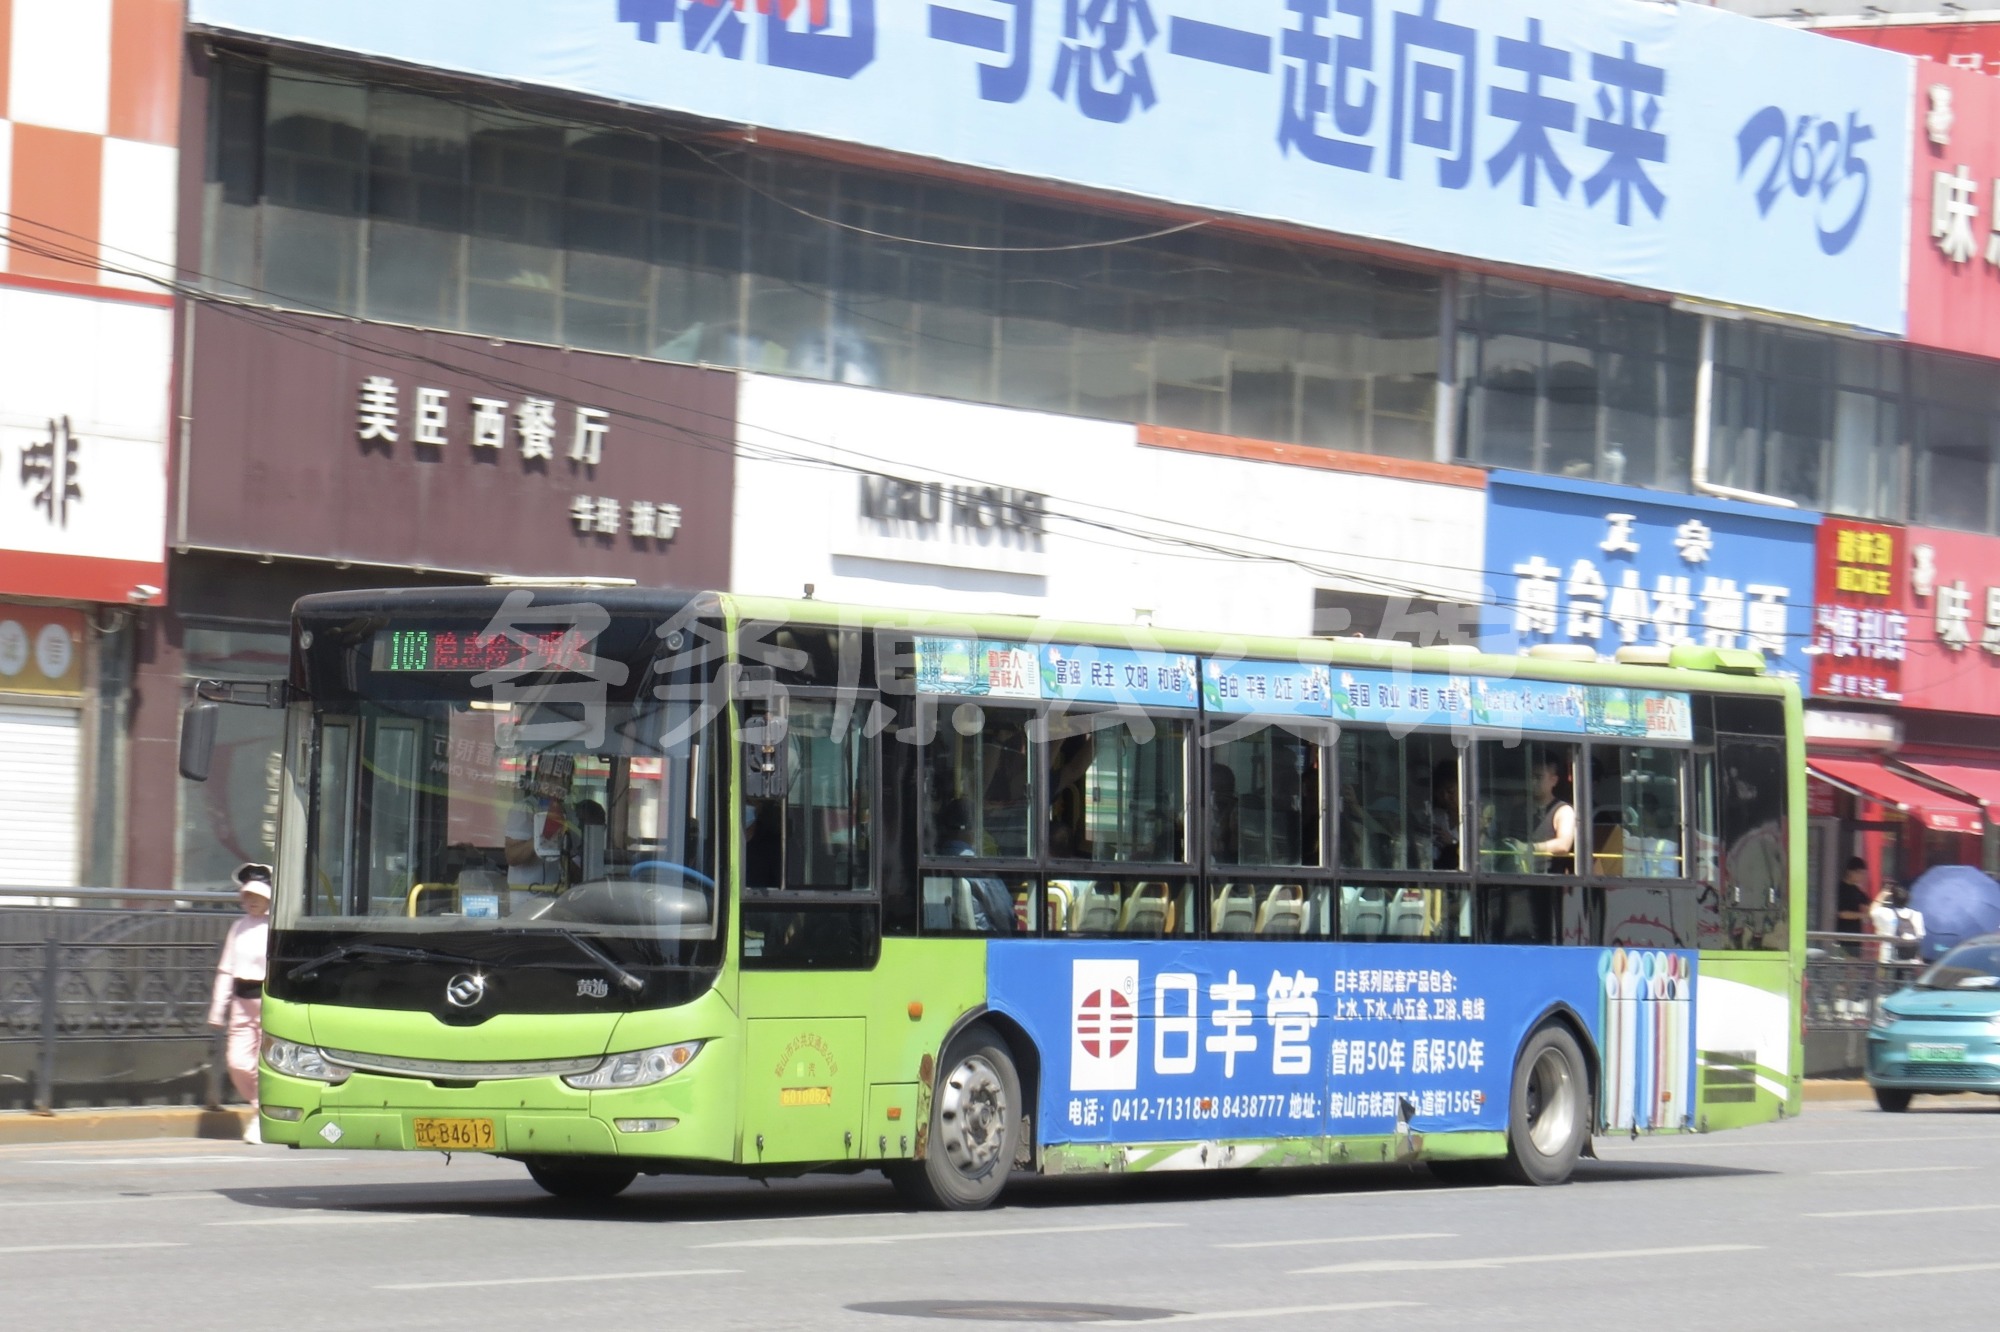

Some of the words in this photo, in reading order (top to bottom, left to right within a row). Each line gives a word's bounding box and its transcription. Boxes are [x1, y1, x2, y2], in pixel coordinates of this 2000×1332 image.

[358, 375, 610, 465] 美臣西餐厅
[570, 494, 621, 534] 牛排
[630, 500, 682, 540] 披萨
[390, 631, 428, 670] 103
[1055, 659, 1081, 685] 富强
[1091, 662, 1115, 687] 民主
[1124, 664, 1149, 690] 文明
[1157, 666, 1182, 692] 和谐
[1219, 674, 1239, 698] 自由
[1246, 675, 1266, 700] 平等
[1273, 677, 1293, 700] 公正
[1348, 684, 1371, 707] 爱国
[1378, 685, 1400, 708] 敬业
[1408, 686, 1430, 710] 诚信
[1436, 687, 1458, 711] 友善
[576, 978, 609, 998] 黄海
[1334, 969, 1458, 994] 日丰系列配套产品包含：
[1153, 968, 1320, 1080] 日丰管
[1331, 1038, 1406, 1076] 管用50年
[1411, 1037, 1485, 1075] 质保50年
[1222, 1094, 1285, 1119] 8438777
